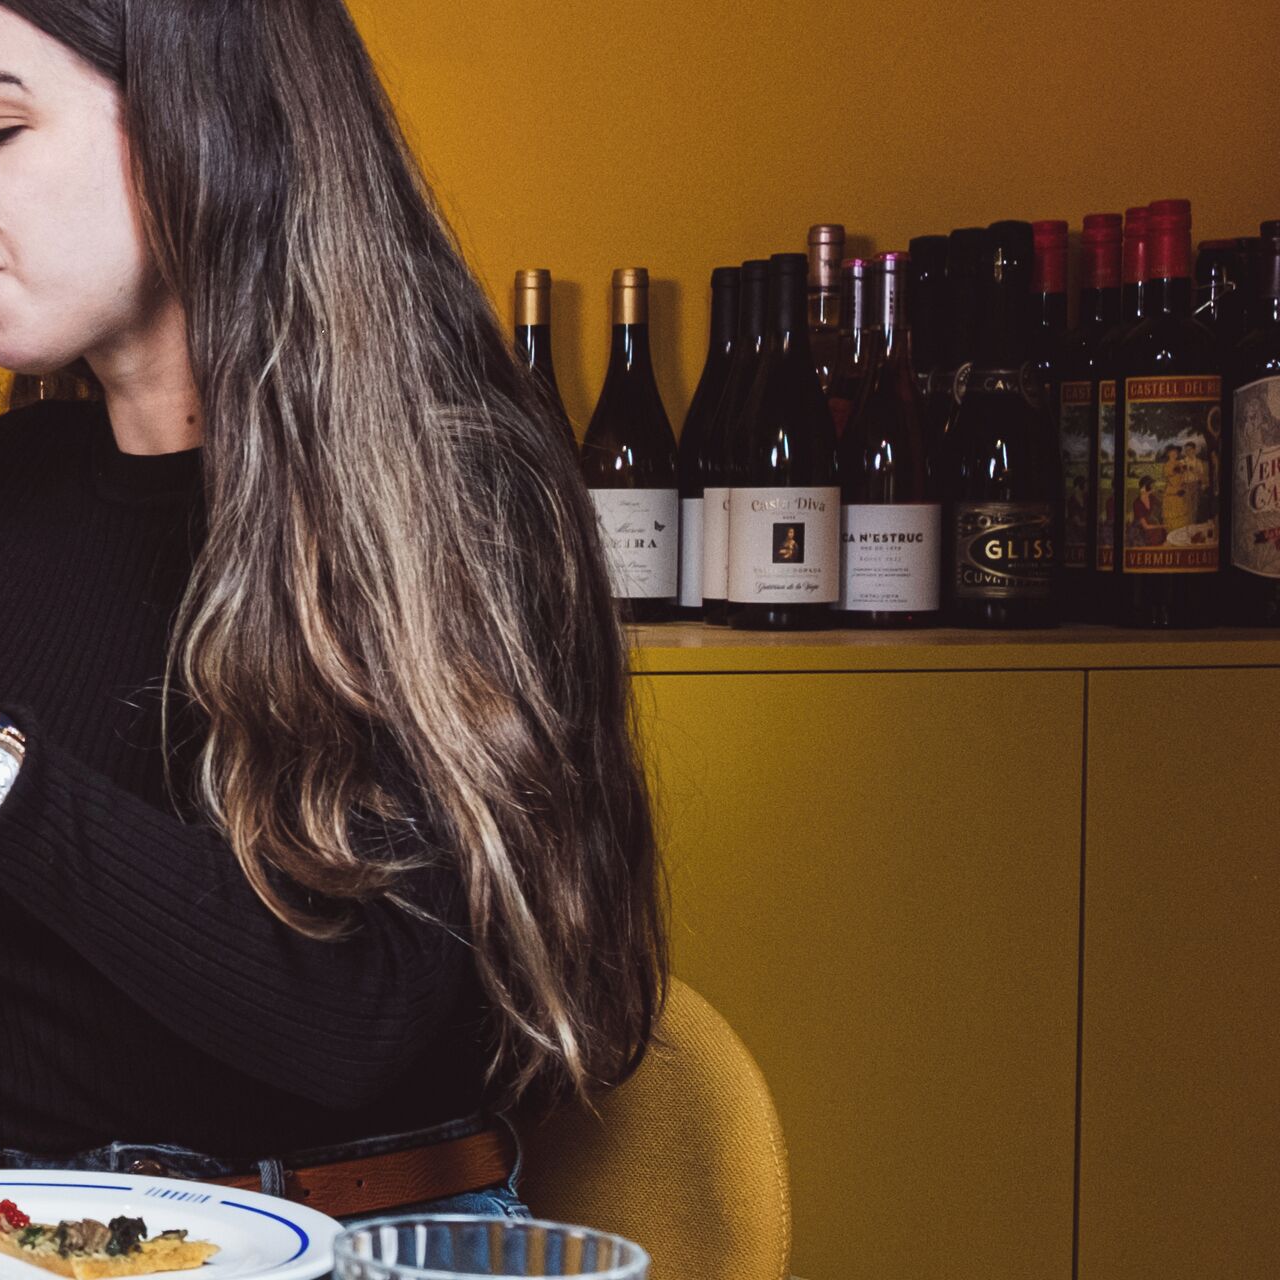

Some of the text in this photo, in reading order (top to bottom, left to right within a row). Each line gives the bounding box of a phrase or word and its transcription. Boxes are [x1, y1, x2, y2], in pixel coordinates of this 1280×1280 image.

[1130, 383, 1179, 396] CASTELL
[795, 496, 827, 512] Diva
[859, 532, 924, 543] N'ESTRUC
[1130, 552, 1180, 566] VERMUT
